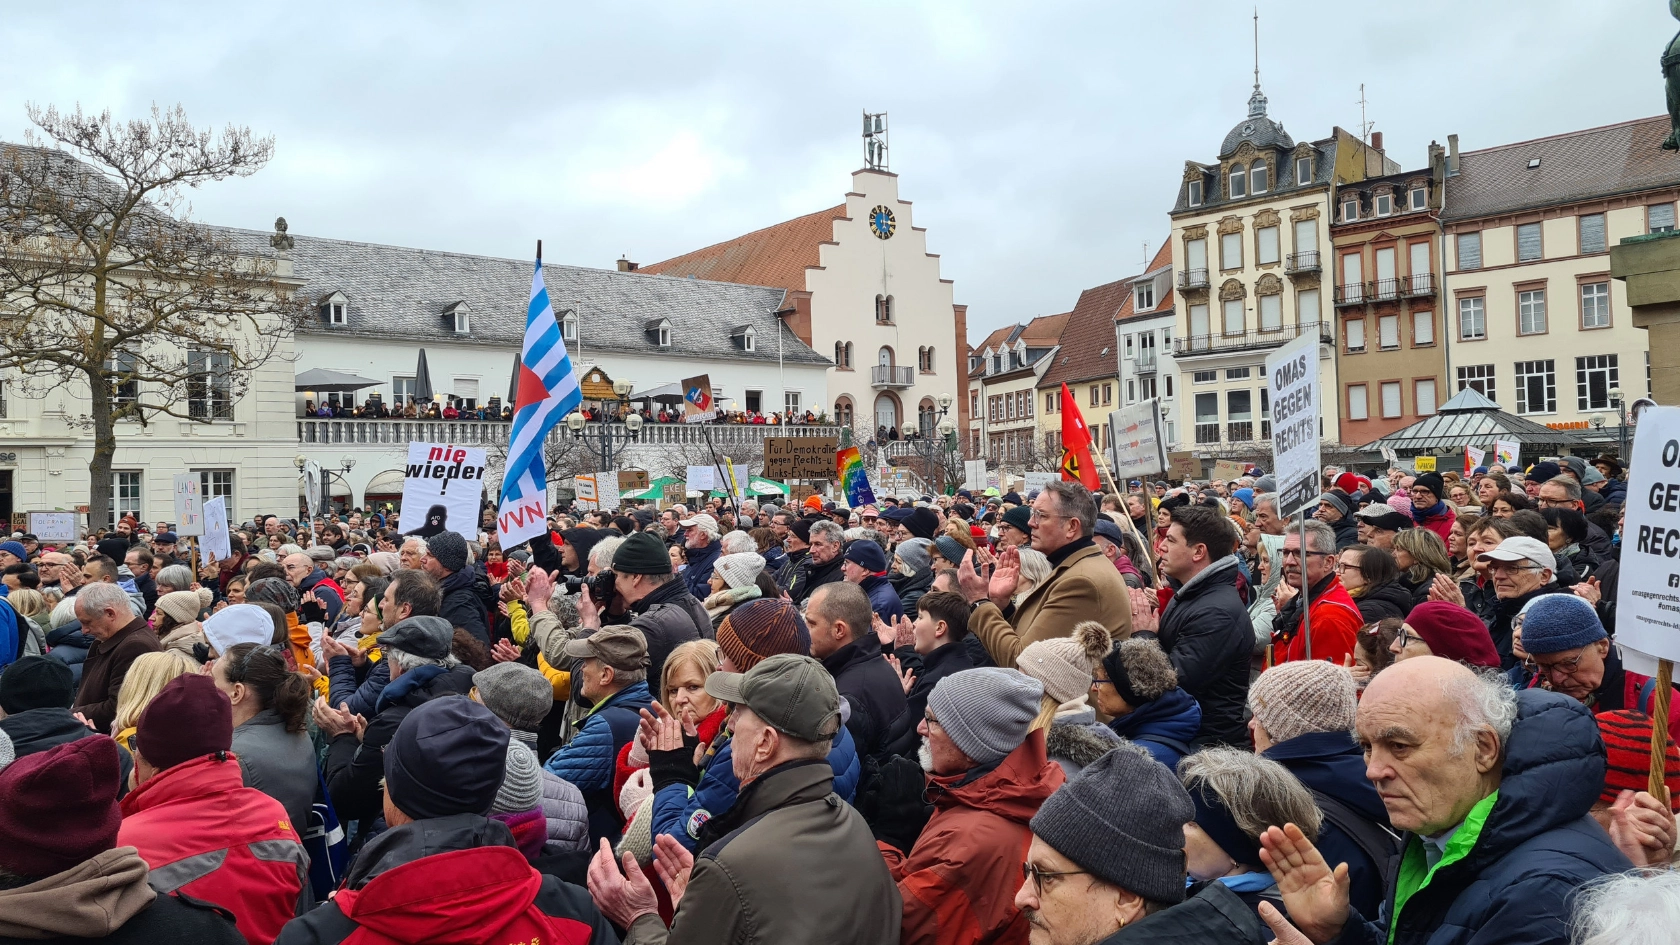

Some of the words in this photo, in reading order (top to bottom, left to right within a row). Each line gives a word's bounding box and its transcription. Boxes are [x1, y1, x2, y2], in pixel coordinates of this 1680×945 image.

[1275, 354, 1306, 391] OMAS
[1273, 383, 1312, 424] GEGEN
[1546, 421, 1589, 431] DROGERIE
[1274, 414, 1314, 457] RECHTS
[428, 445, 467, 463] nie
[769, 440, 783, 454] Für
[786, 440, 837, 454] Demokratie
[1661, 439, 1680, 468] O
[769, 457, 791, 466] gegen
[405, 461, 485, 480] wieder
[767, 466, 838, 478] Links-Extremisten
[177, 481, 200, 494] LANDAU
[663, 484, 685, 493] EKEL
[185, 499, 193, 511] IST
[1649, 482, 1680, 513] GE
[181, 512, 198, 527] BUNT
[499, 501, 545, 535] VVN
[36, 531, 69, 539] VIELFALT
[1637, 524, 1680, 559] REC
[1658, 602, 1680, 614] #omas
